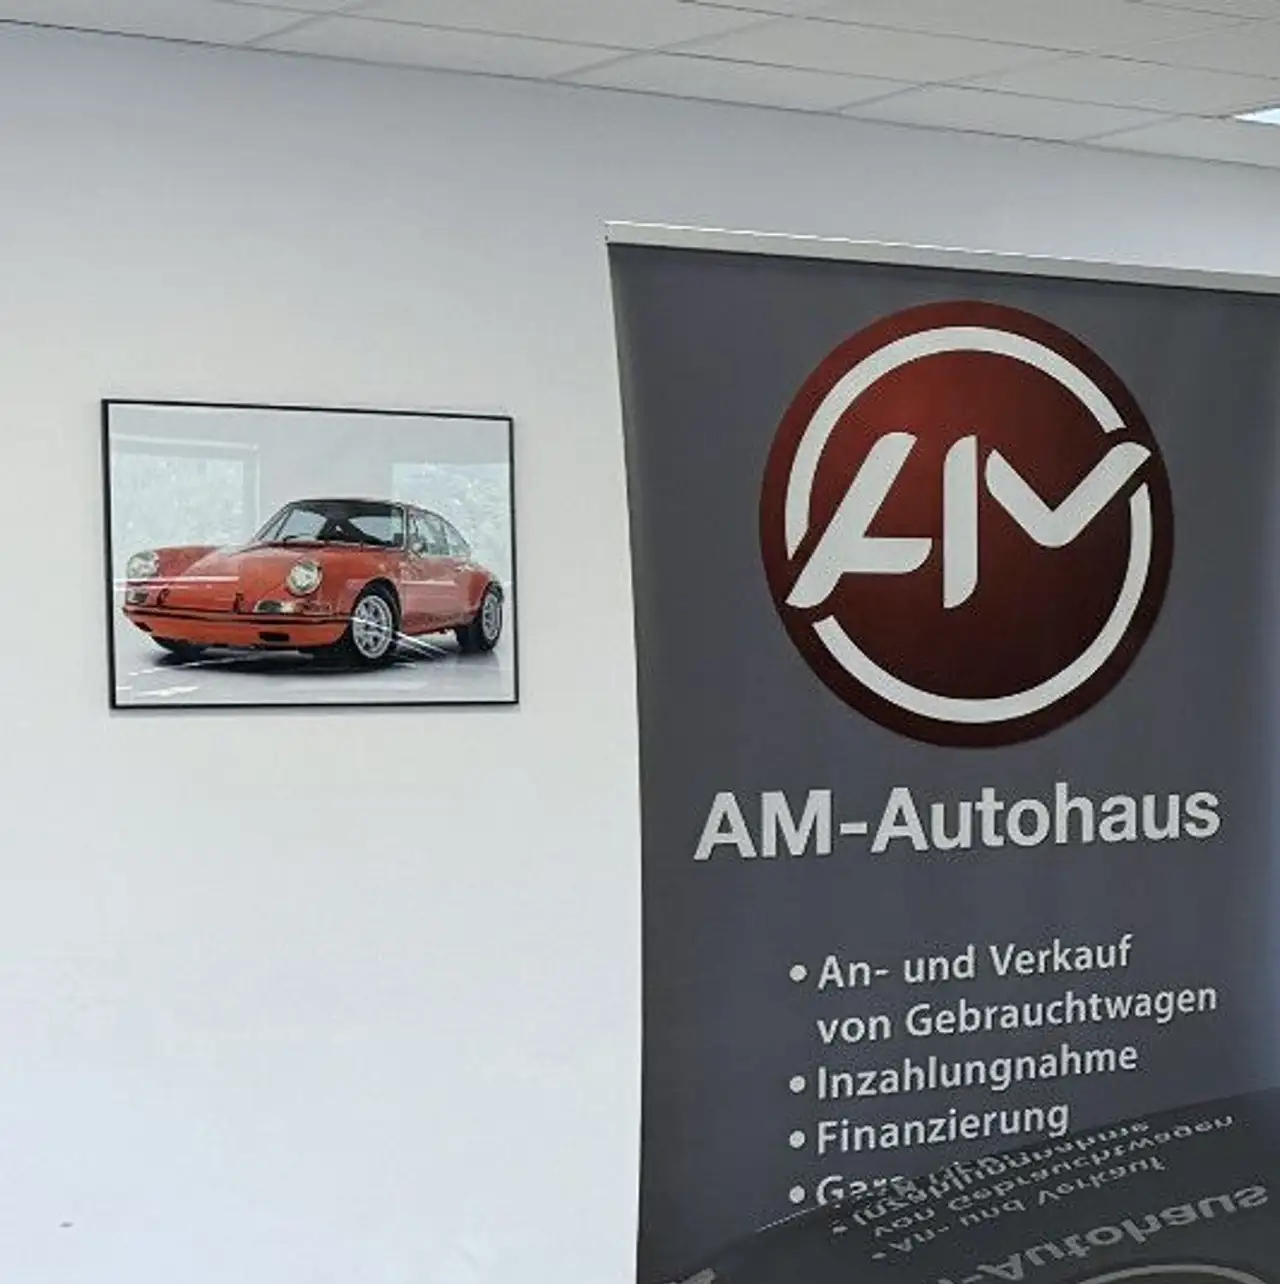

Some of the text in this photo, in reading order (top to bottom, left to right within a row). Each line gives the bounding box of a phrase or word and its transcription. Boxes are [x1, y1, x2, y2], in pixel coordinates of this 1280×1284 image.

[693, 782, 1222, 861] AM-Autohaus
[817, 934, 1134, 990] An- und Verkauf
[817, 983, 1218, 1045] von Gebrauchtwagen
[817, 1042, 1139, 1101] Inzahlungnahme
[817, 1101, 1071, 1156] Finanzierung
